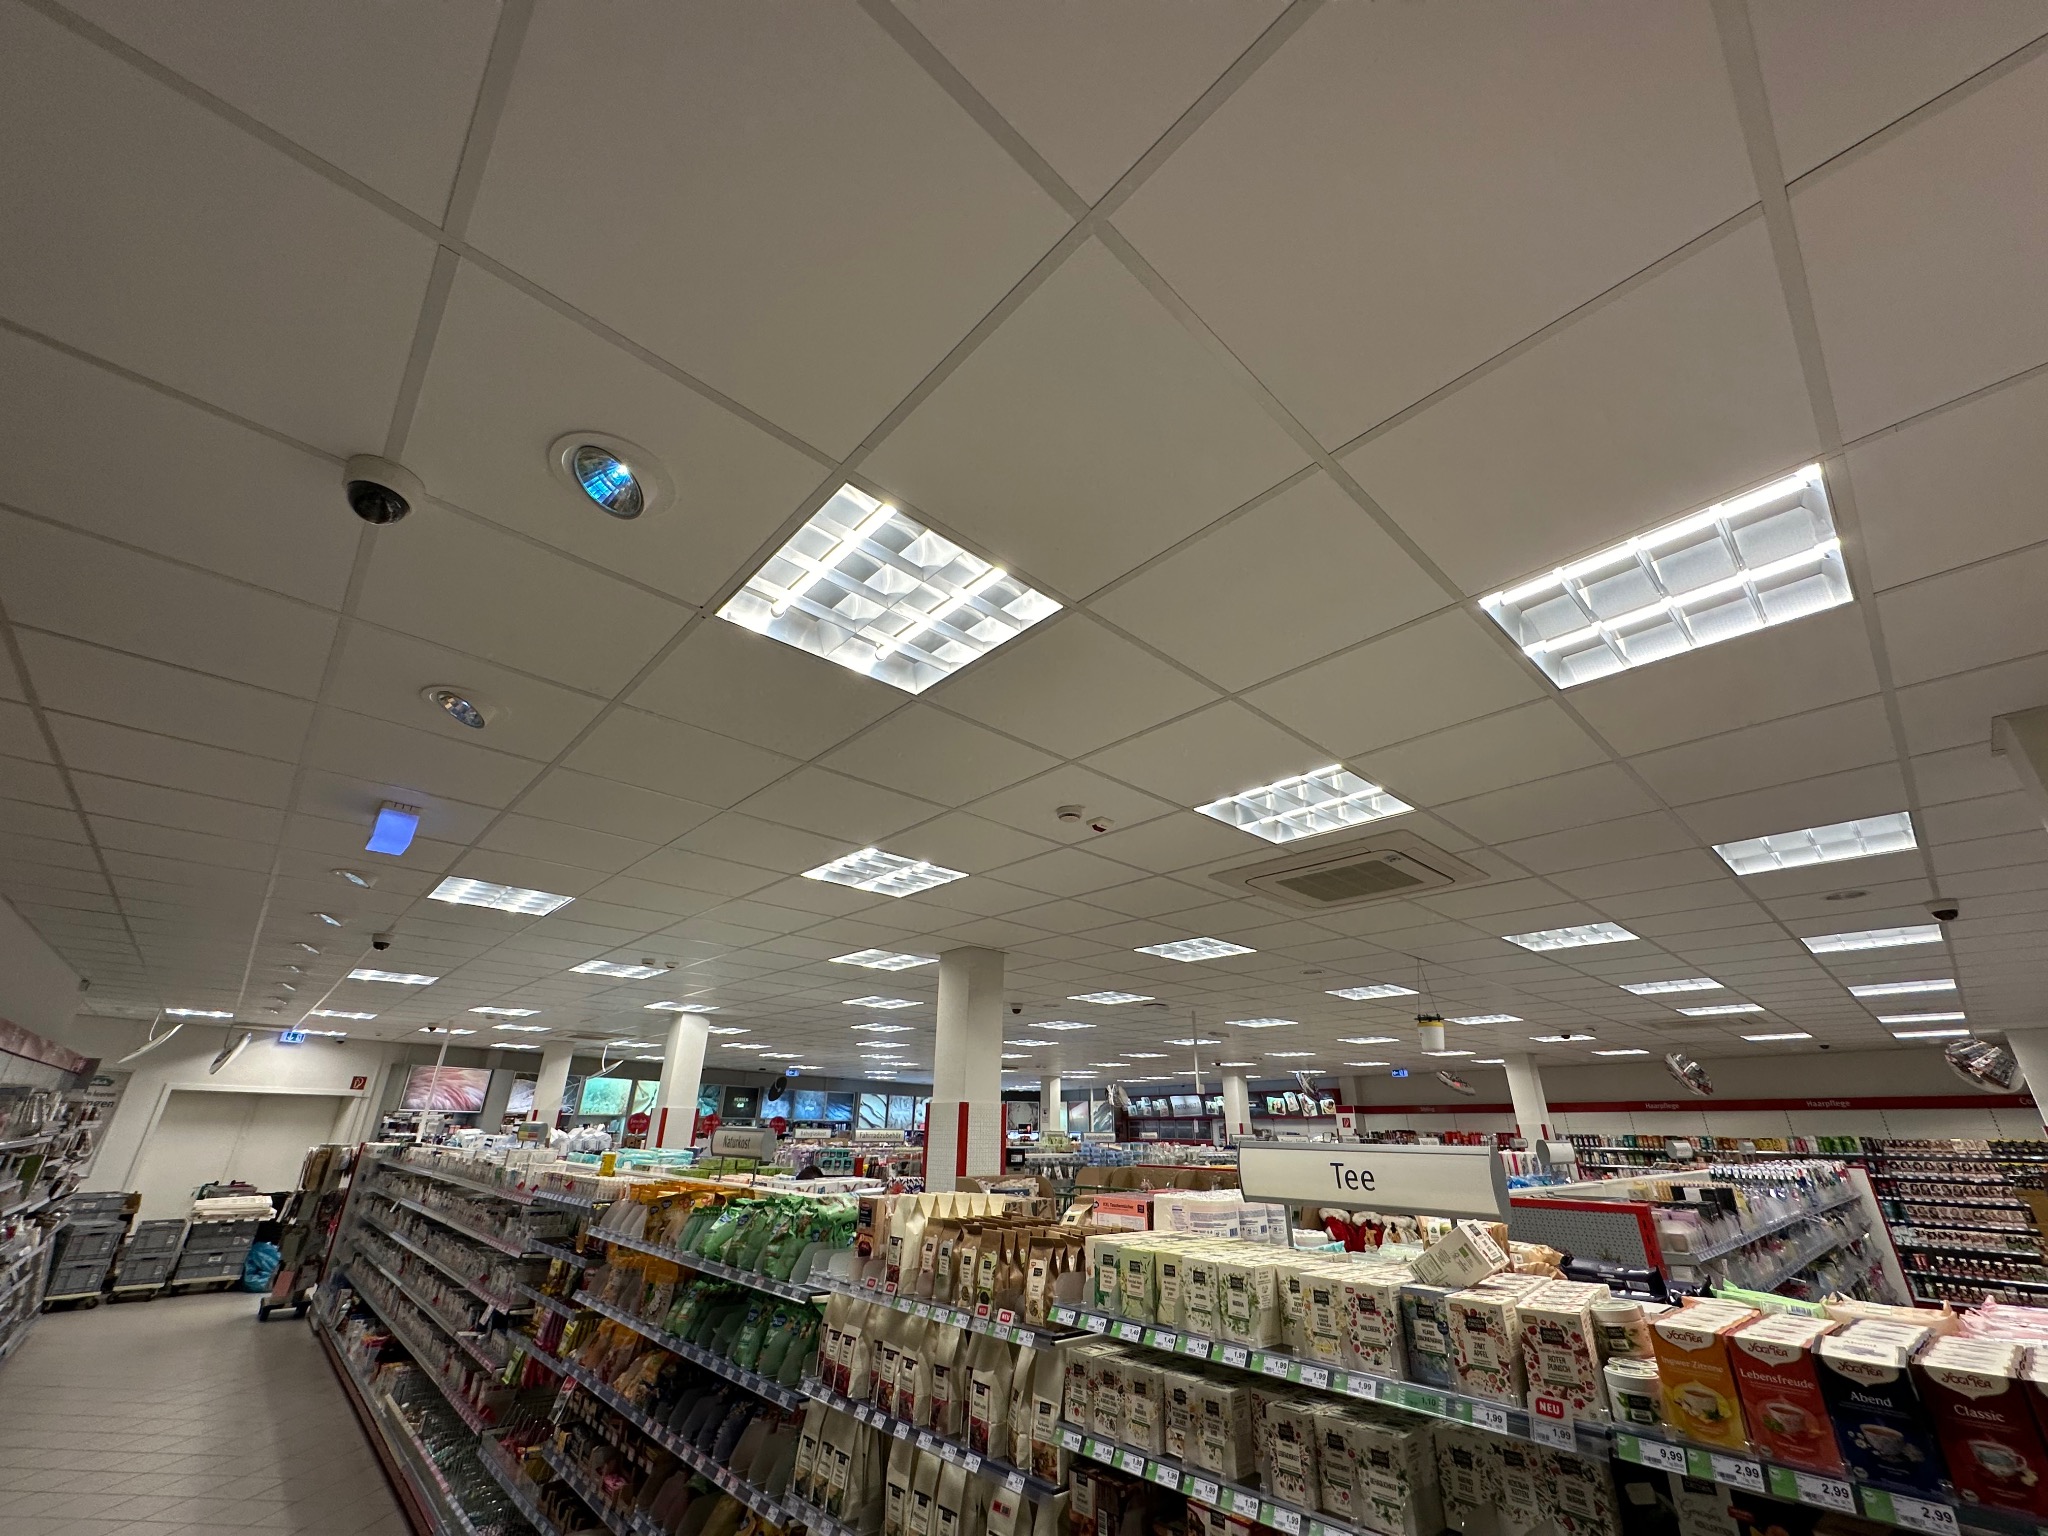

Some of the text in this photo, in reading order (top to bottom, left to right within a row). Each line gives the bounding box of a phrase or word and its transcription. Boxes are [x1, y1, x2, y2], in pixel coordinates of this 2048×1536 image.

[1645, 1102, 1679, 1110] Haarpflege
[1806, 1100, 1850, 1108] Haarpflege
[858, 1131, 901, 1140] Fahrradzubehör
[723, 1135, 751, 1149] Naturkost
[1329, 1162, 1376, 1191] Tee
[1001, 1313, 1010, 1321] NEU
[1163, 1336, 1174, 1344] 1,49
[1686, 1332, 1703, 1344] TEA
[1196, 1342, 1208, 1350] 1,99
[1769, 1345, 1789, 1358] TEA
[1234, 1350, 1246, 1359] 1,99
[1547, 1355, 1566, 1365] ROTER
[1275, 1360, 1287, 1369] 1,99
[1661, 1356, 1724, 1373] Ingwer Zitrone
[1313, 1371, 1326, 1380] 1,99
[1860, 1364, 1884, 1377] TEA
[1740, 1368, 1815, 1390] Lebensfreude
[1967, 1375, 1993, 1389] TEA
[1357, 1381, 1372, 1390] 1,99
[1422, 1397, 1436, 1407] 1,10
[1850, 1391, 1893, 1408] Abend
[1539, 1401, 1560, 1414] NEU
[1953, 1404, 2006, 1422] Classic
[1485, 1412, 1503, 1423] 1,99
[1553, 1428, 1571, 1440] 1,99
[1660, 1448, 1683, 1462] 9,99
[1167, 1471, 1178, 1480] 1,99
[1734, 1463, 1760, 1479] 2,99
[1015, 1476, 1023, 1485] 2,79
[1205, 1485, 1216, 1495] 1,99
[1821, 1483, 1849, 1499] 2,99
[1245, 1498, 1257, 1510] 1,99
[1286, 1514, 1299, 1525] 1,99
[1921, 1506, 1953, 1523] 2,99
